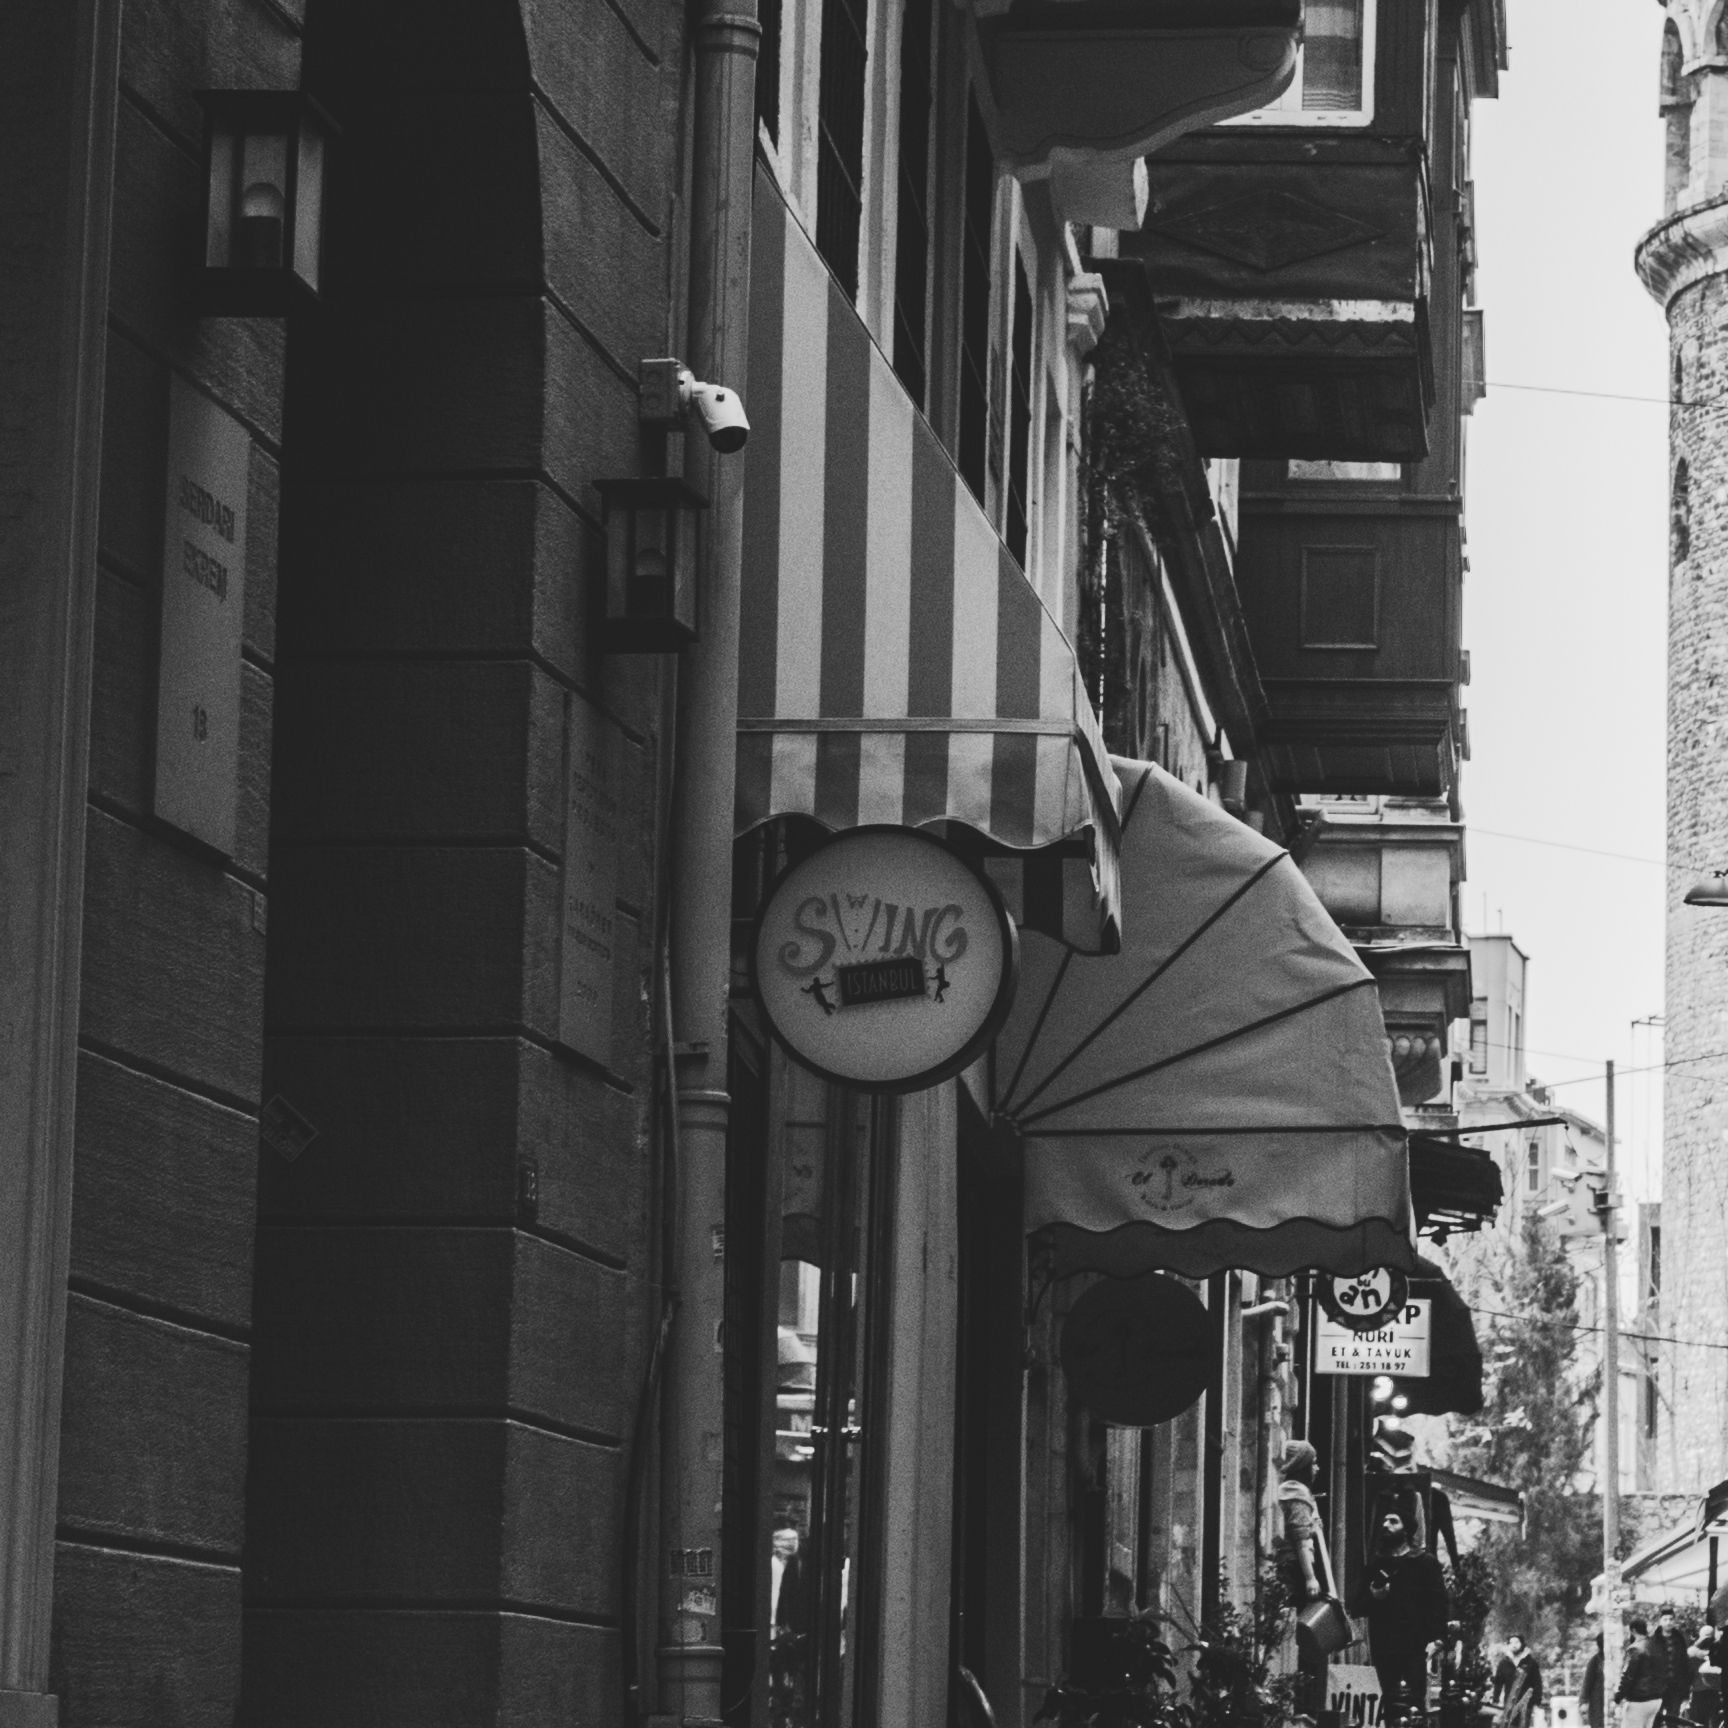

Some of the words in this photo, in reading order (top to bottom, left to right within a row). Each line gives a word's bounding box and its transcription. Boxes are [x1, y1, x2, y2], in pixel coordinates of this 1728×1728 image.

[778, 892, 968, 975] SWING
[1332, 1347, 1346, 1357] ET
[1367, 1348, 1411, 1359] TAVUK
